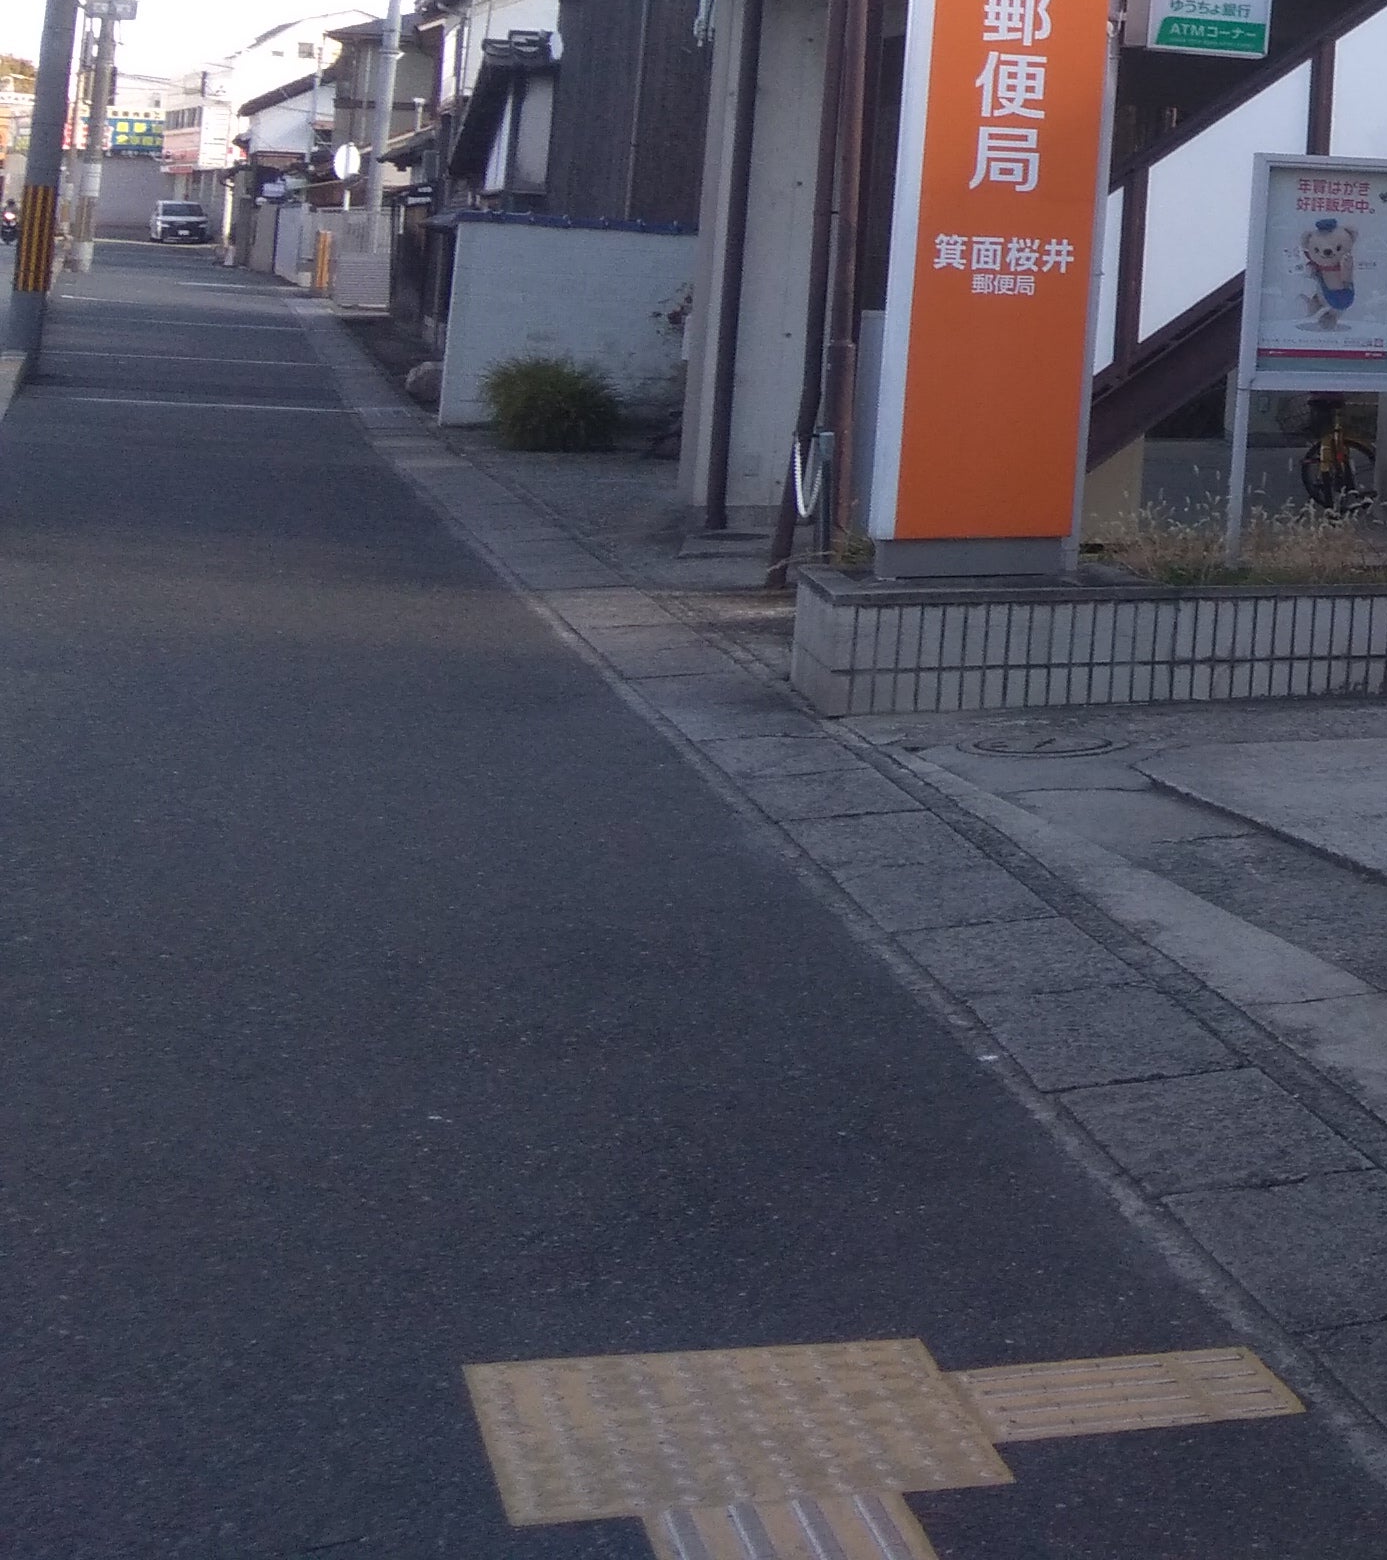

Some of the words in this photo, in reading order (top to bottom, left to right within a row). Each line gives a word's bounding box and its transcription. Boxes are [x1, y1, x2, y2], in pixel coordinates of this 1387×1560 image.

[1170, 22, 1257, 40] ATMコーナー
[1297, 178, 1372, 198] 年賀はがき
[932, 232, 1076, 274] 箕面桜井
[970, 272, 1037, 297] 郵便局
